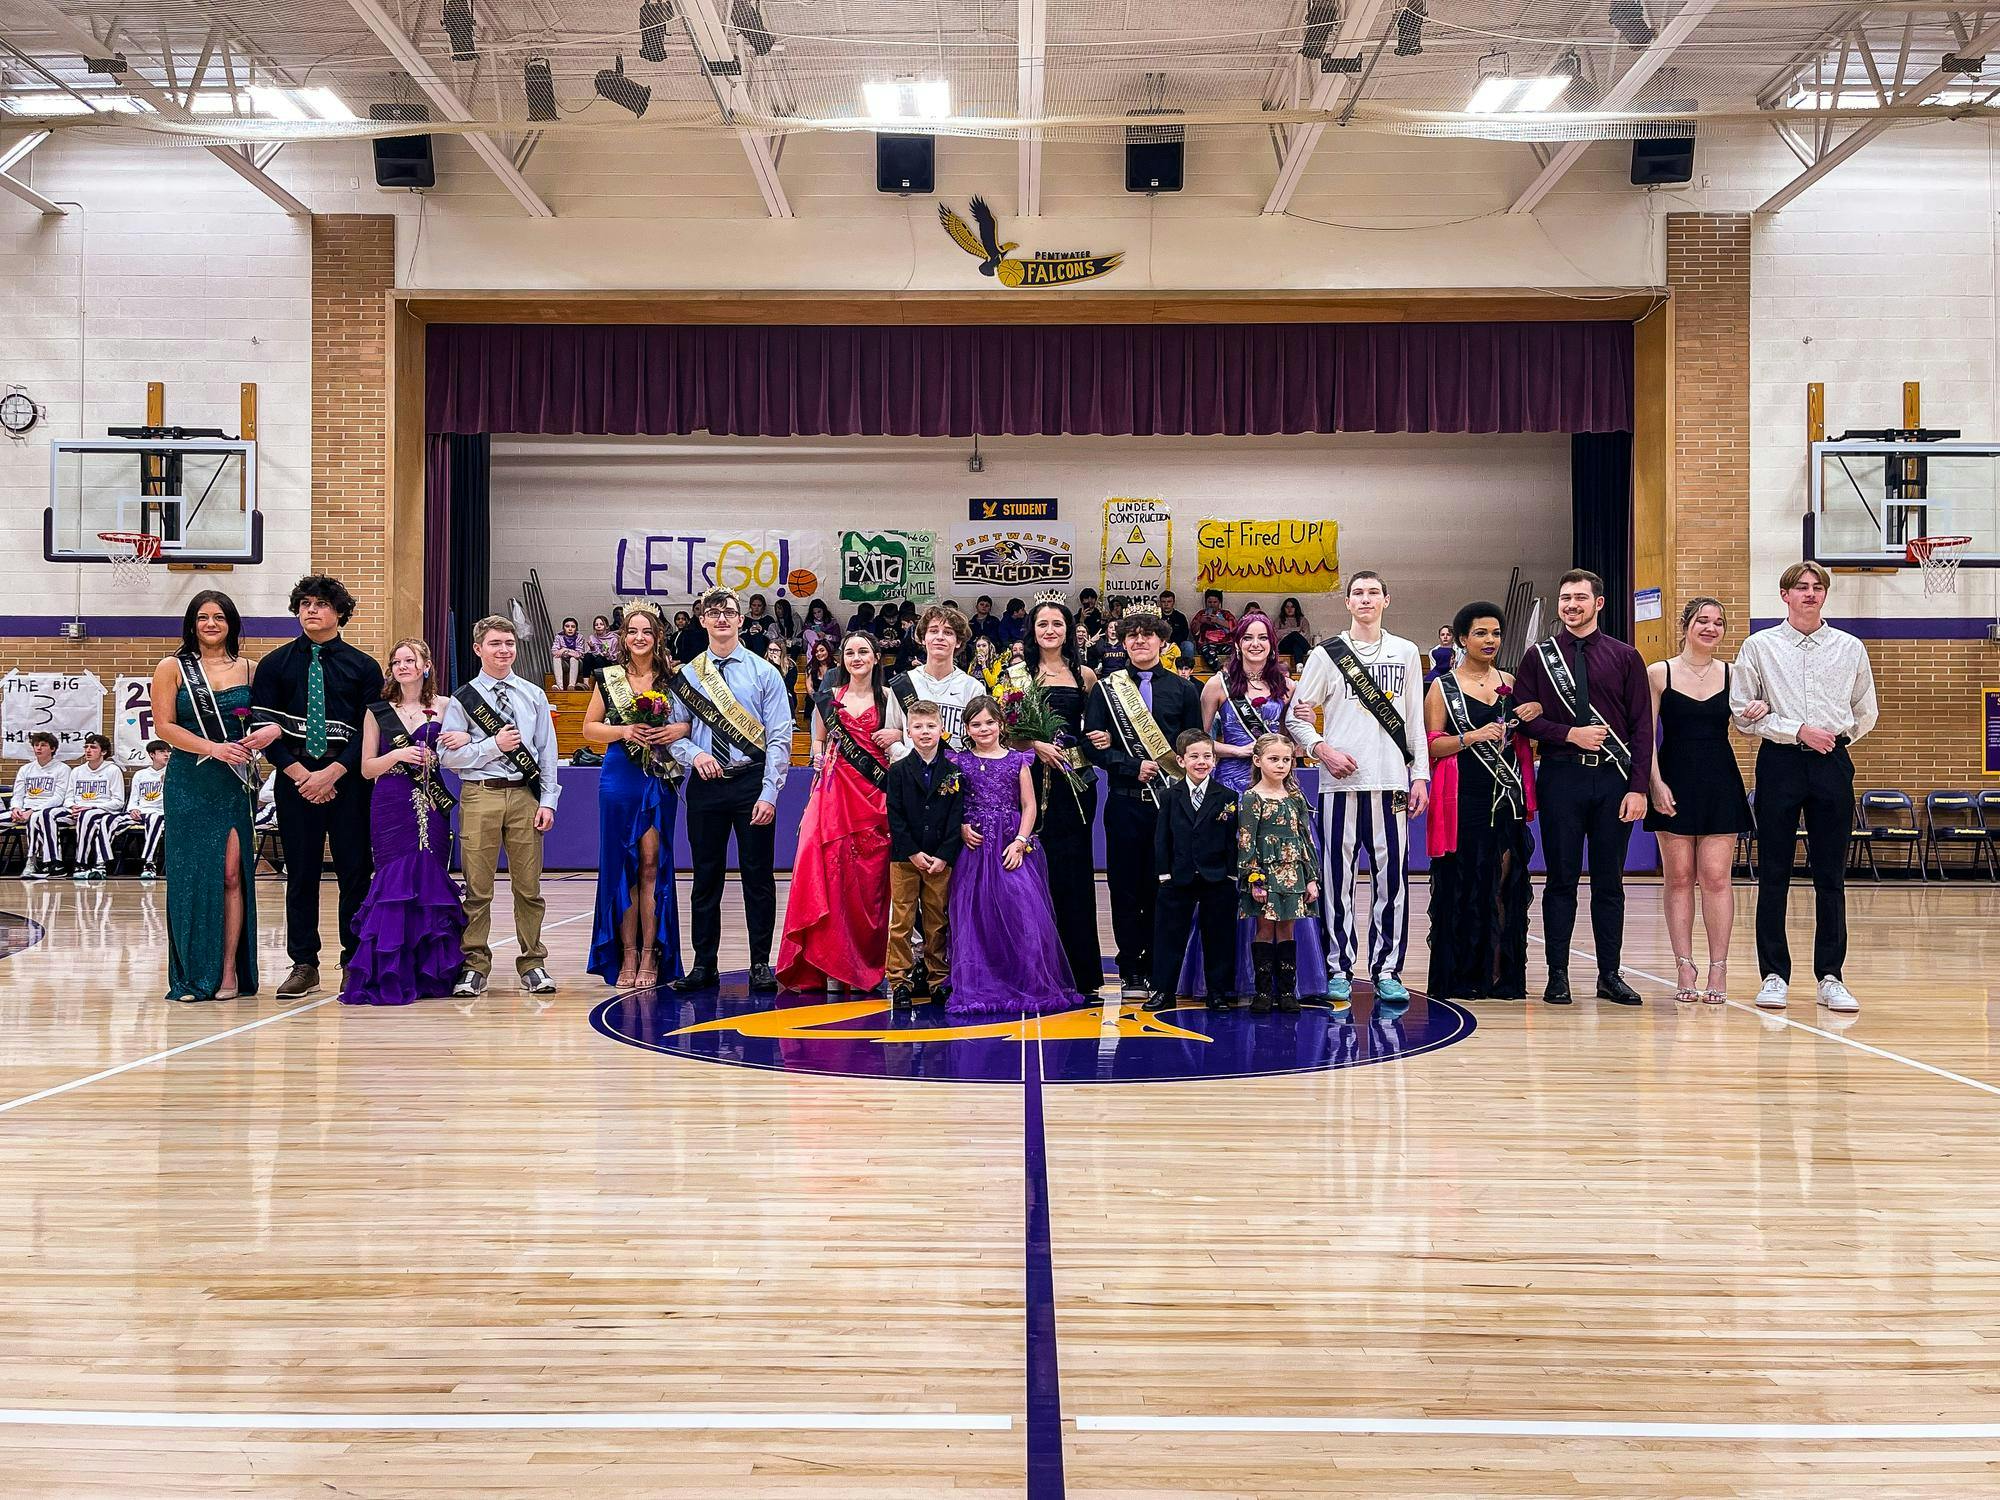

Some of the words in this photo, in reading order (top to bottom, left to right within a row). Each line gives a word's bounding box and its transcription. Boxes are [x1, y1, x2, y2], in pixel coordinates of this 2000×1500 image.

[1035, 251, 1091, 260] PENTWATER
[1027, 261, 1095, 283] FALCONS
[1002, 502, 1048, 517] STUDENT
[1117, 503, 1155, 511] UNDER
[1109, 513, 1171, 524] CONSTRUCTION
[955, 530, 1070, 552] PENTWATER
[1198, 524, 1234, 549] Get
[1241, 524, 1281, 546] Fired
[1290, 523, 1323, 544] UP!
[909, 546, 925, 558] THE
[908, 560, 935, 572] EXTRA
[953, 553, 1073, 583] FALCONS
[909, 581, 935, 595] MILE
[1106, 580, 1159, 590] BUILDING
[34, 695, 56, 725] 3
[704, 673, 738, 716] HOMECOMING
[736, 712, 762, 738] PRINCE
[1376, 702, 1401, 731] COURT
[718, 718, 744, 743] COURT
[1120, 685, 1154, 734] HOMECOMING
[1147, 731, 1167, 756] KING
[128, 749, 146, 761] in
[430, 781, 453, 809] COURT
